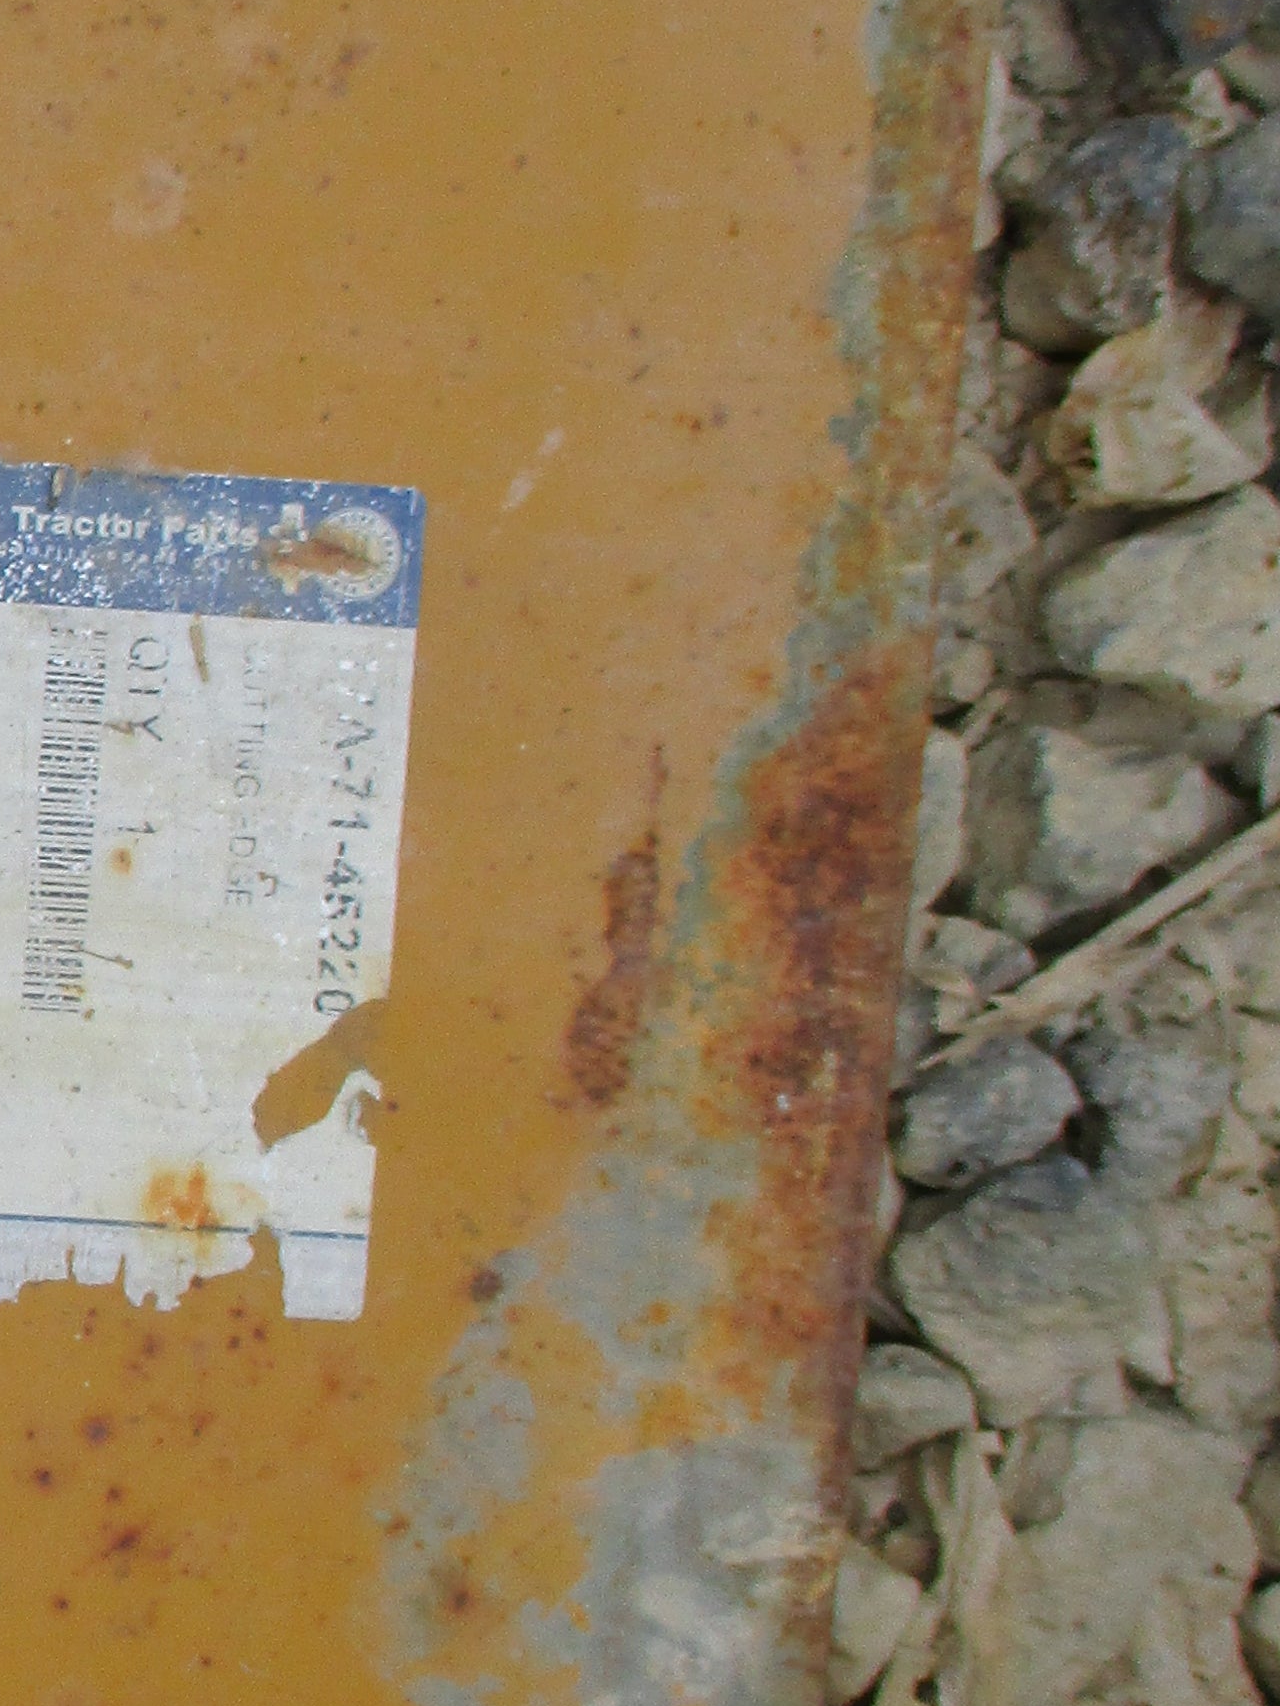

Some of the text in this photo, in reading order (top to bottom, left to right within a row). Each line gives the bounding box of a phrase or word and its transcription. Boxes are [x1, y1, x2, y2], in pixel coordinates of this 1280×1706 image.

[10, 504, 151, 541] Tractor
[162, 514, 260, 548] Parts
[121, 636, 171, 742] QTY
[314, 657, 379, 1018] 7A-71-45220
